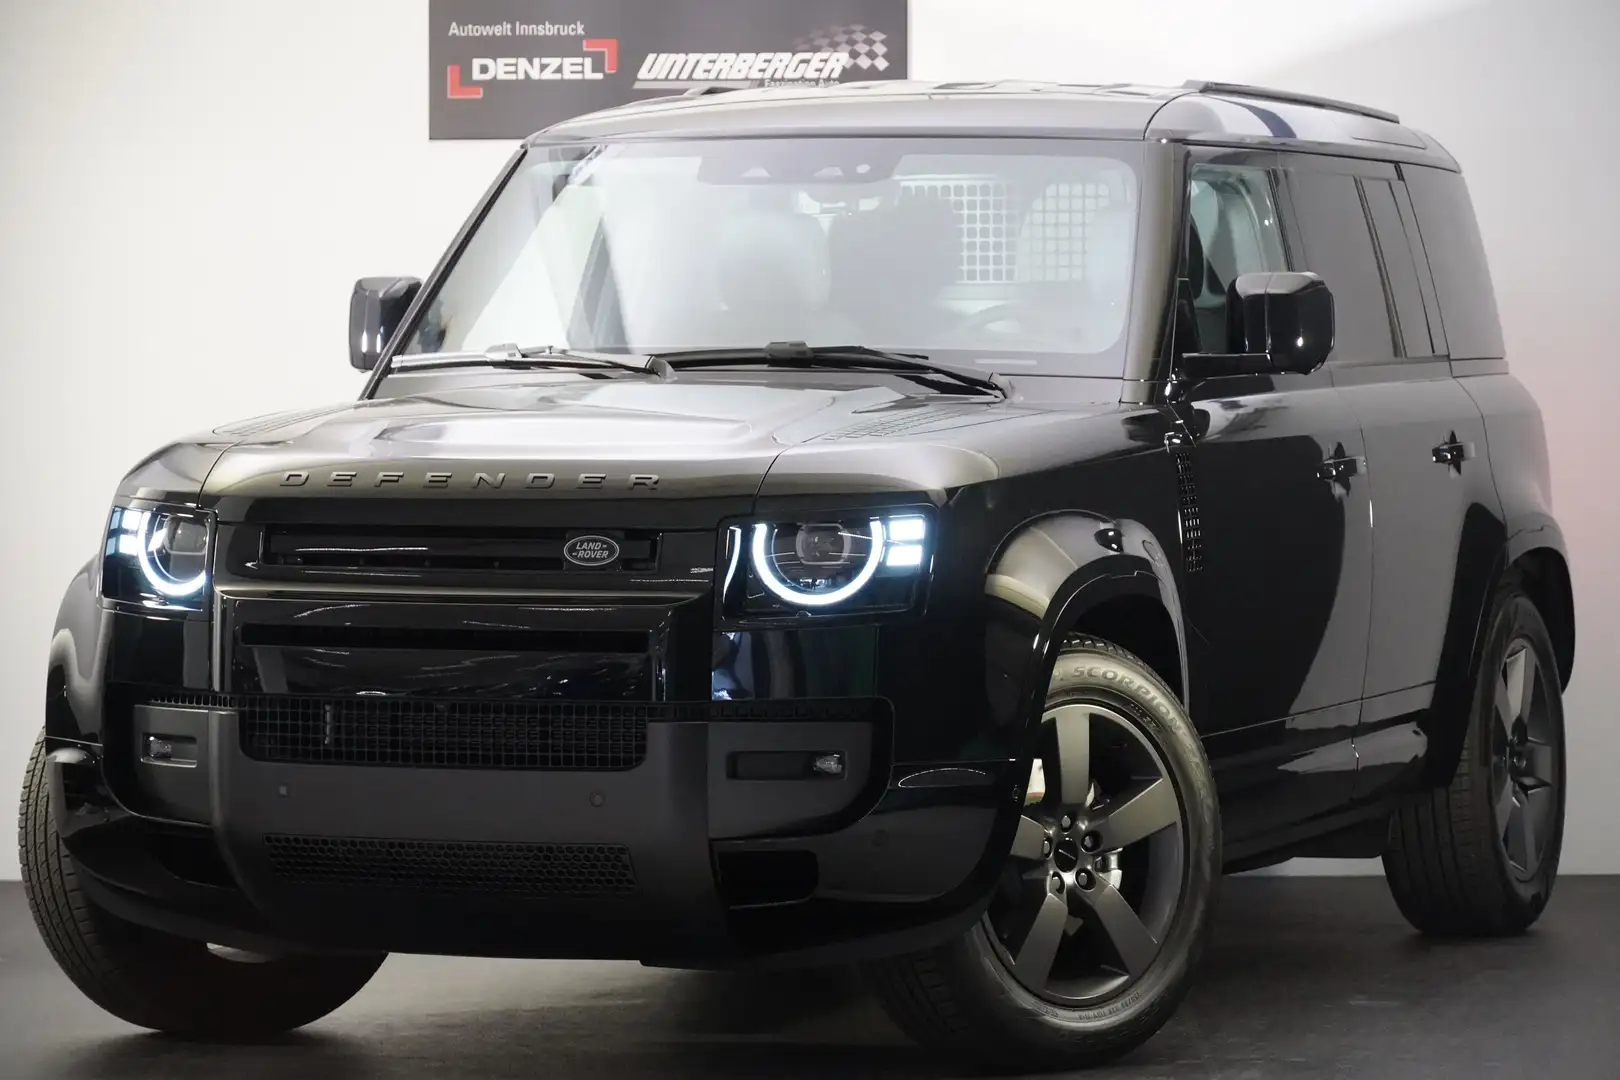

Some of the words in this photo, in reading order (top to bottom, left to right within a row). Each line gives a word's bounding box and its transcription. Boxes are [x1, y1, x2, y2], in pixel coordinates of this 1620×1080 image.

[448, 21, 512, 36] Autowelt
[515, 20, 585, 36] Innsbruck
[471, 57, 604, 81] DENZEL
[637, 52, 850, 80] UNTERBERGER
[279, 471, 660, 491] DEFENDER
[1071, 665, 1182, 733] SCORPION
